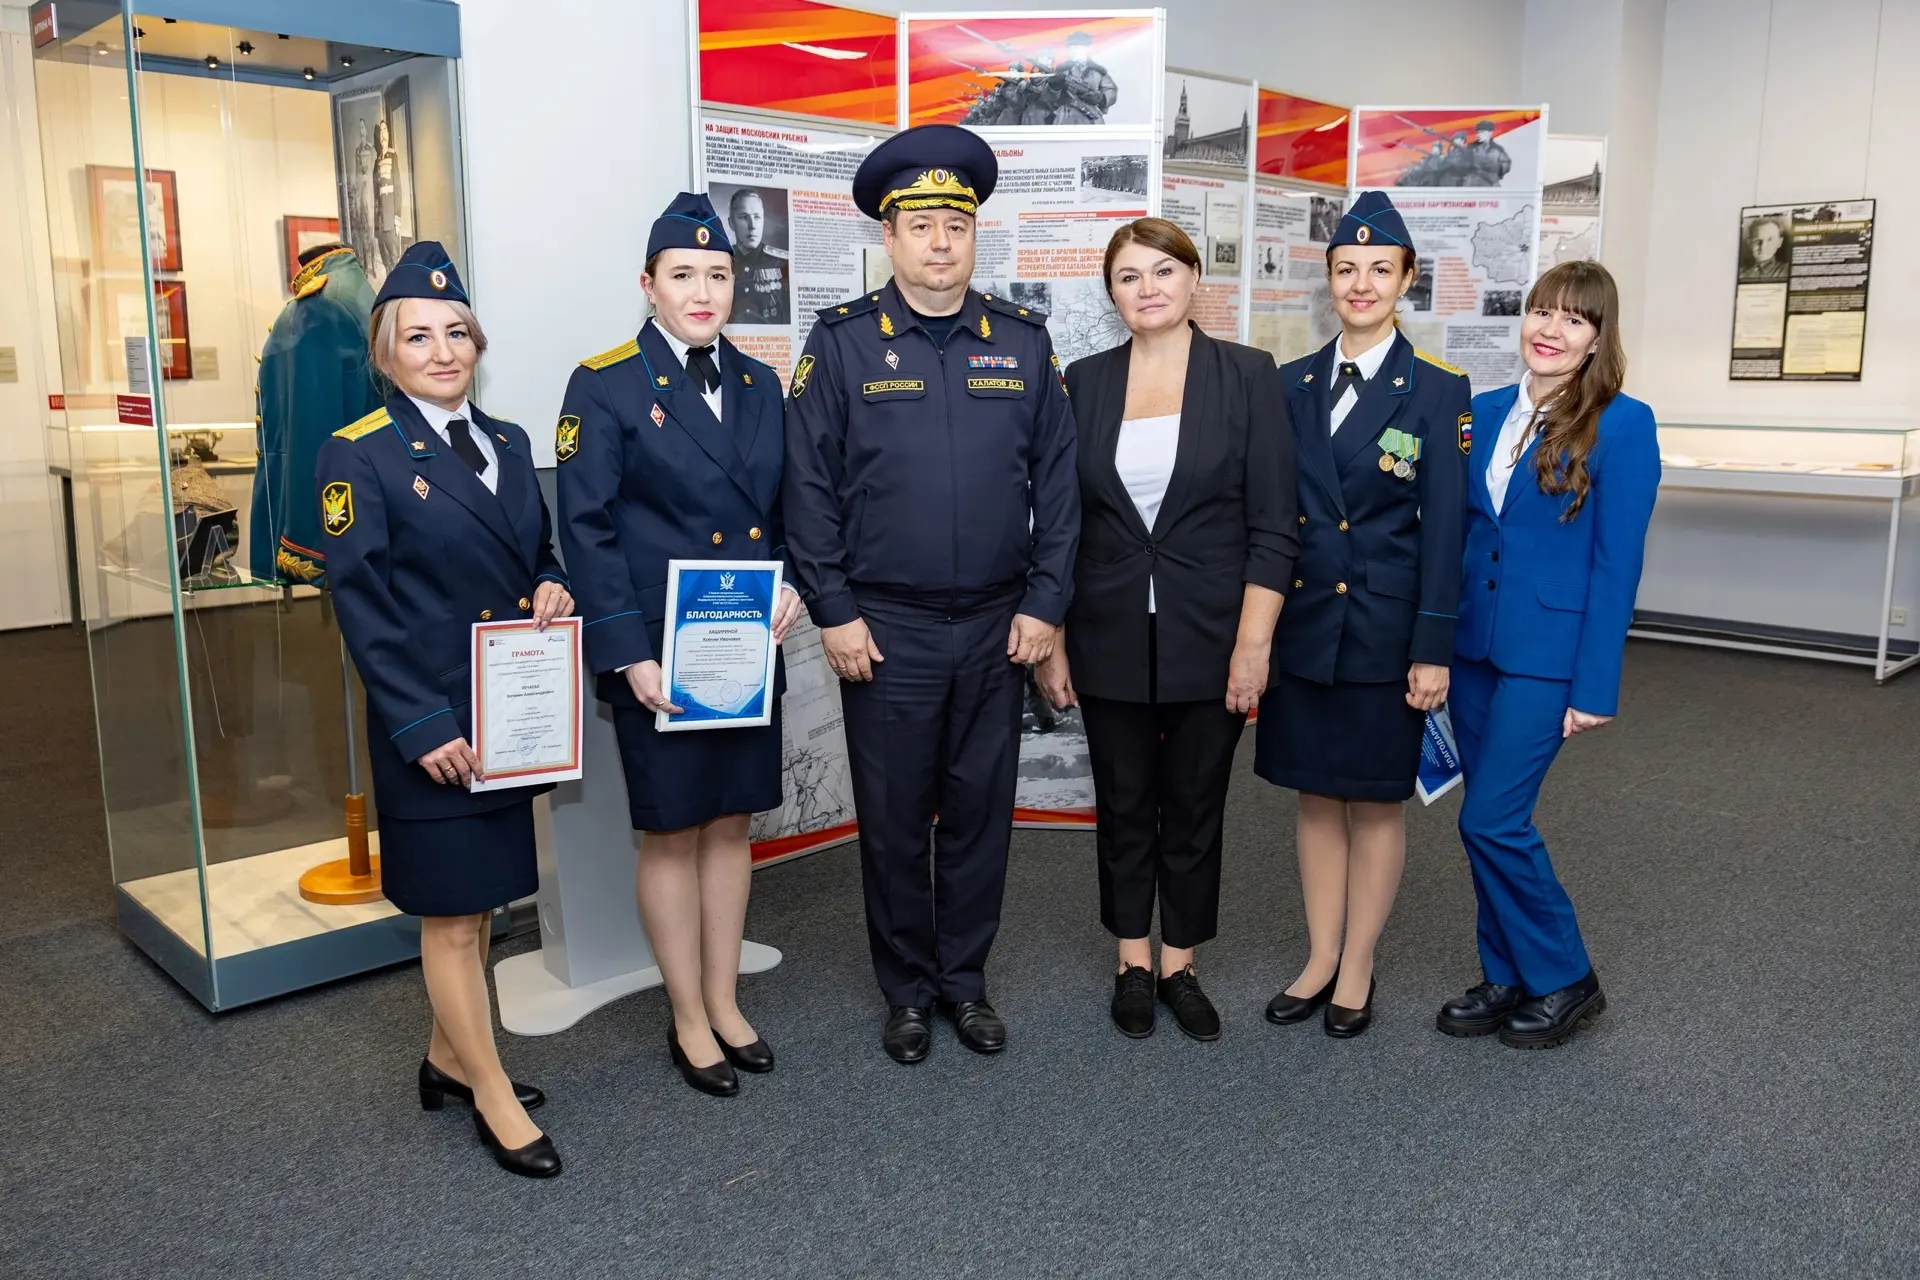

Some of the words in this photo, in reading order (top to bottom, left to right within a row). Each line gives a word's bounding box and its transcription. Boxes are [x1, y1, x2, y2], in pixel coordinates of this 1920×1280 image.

[705, 124, 713, 132] НА
[716, 124, 739, 135] ЗАЩИТЕ
[741, 128, 779, 139] МОСКОВСКИХ
[781, 132, 808, 143] РУБЕЖЕЙ
[686, 610, 762, 620] БЛАГОДАРНОСТЬ
[1425, 715, 1455, 768] БЛАГОДАРНОС
